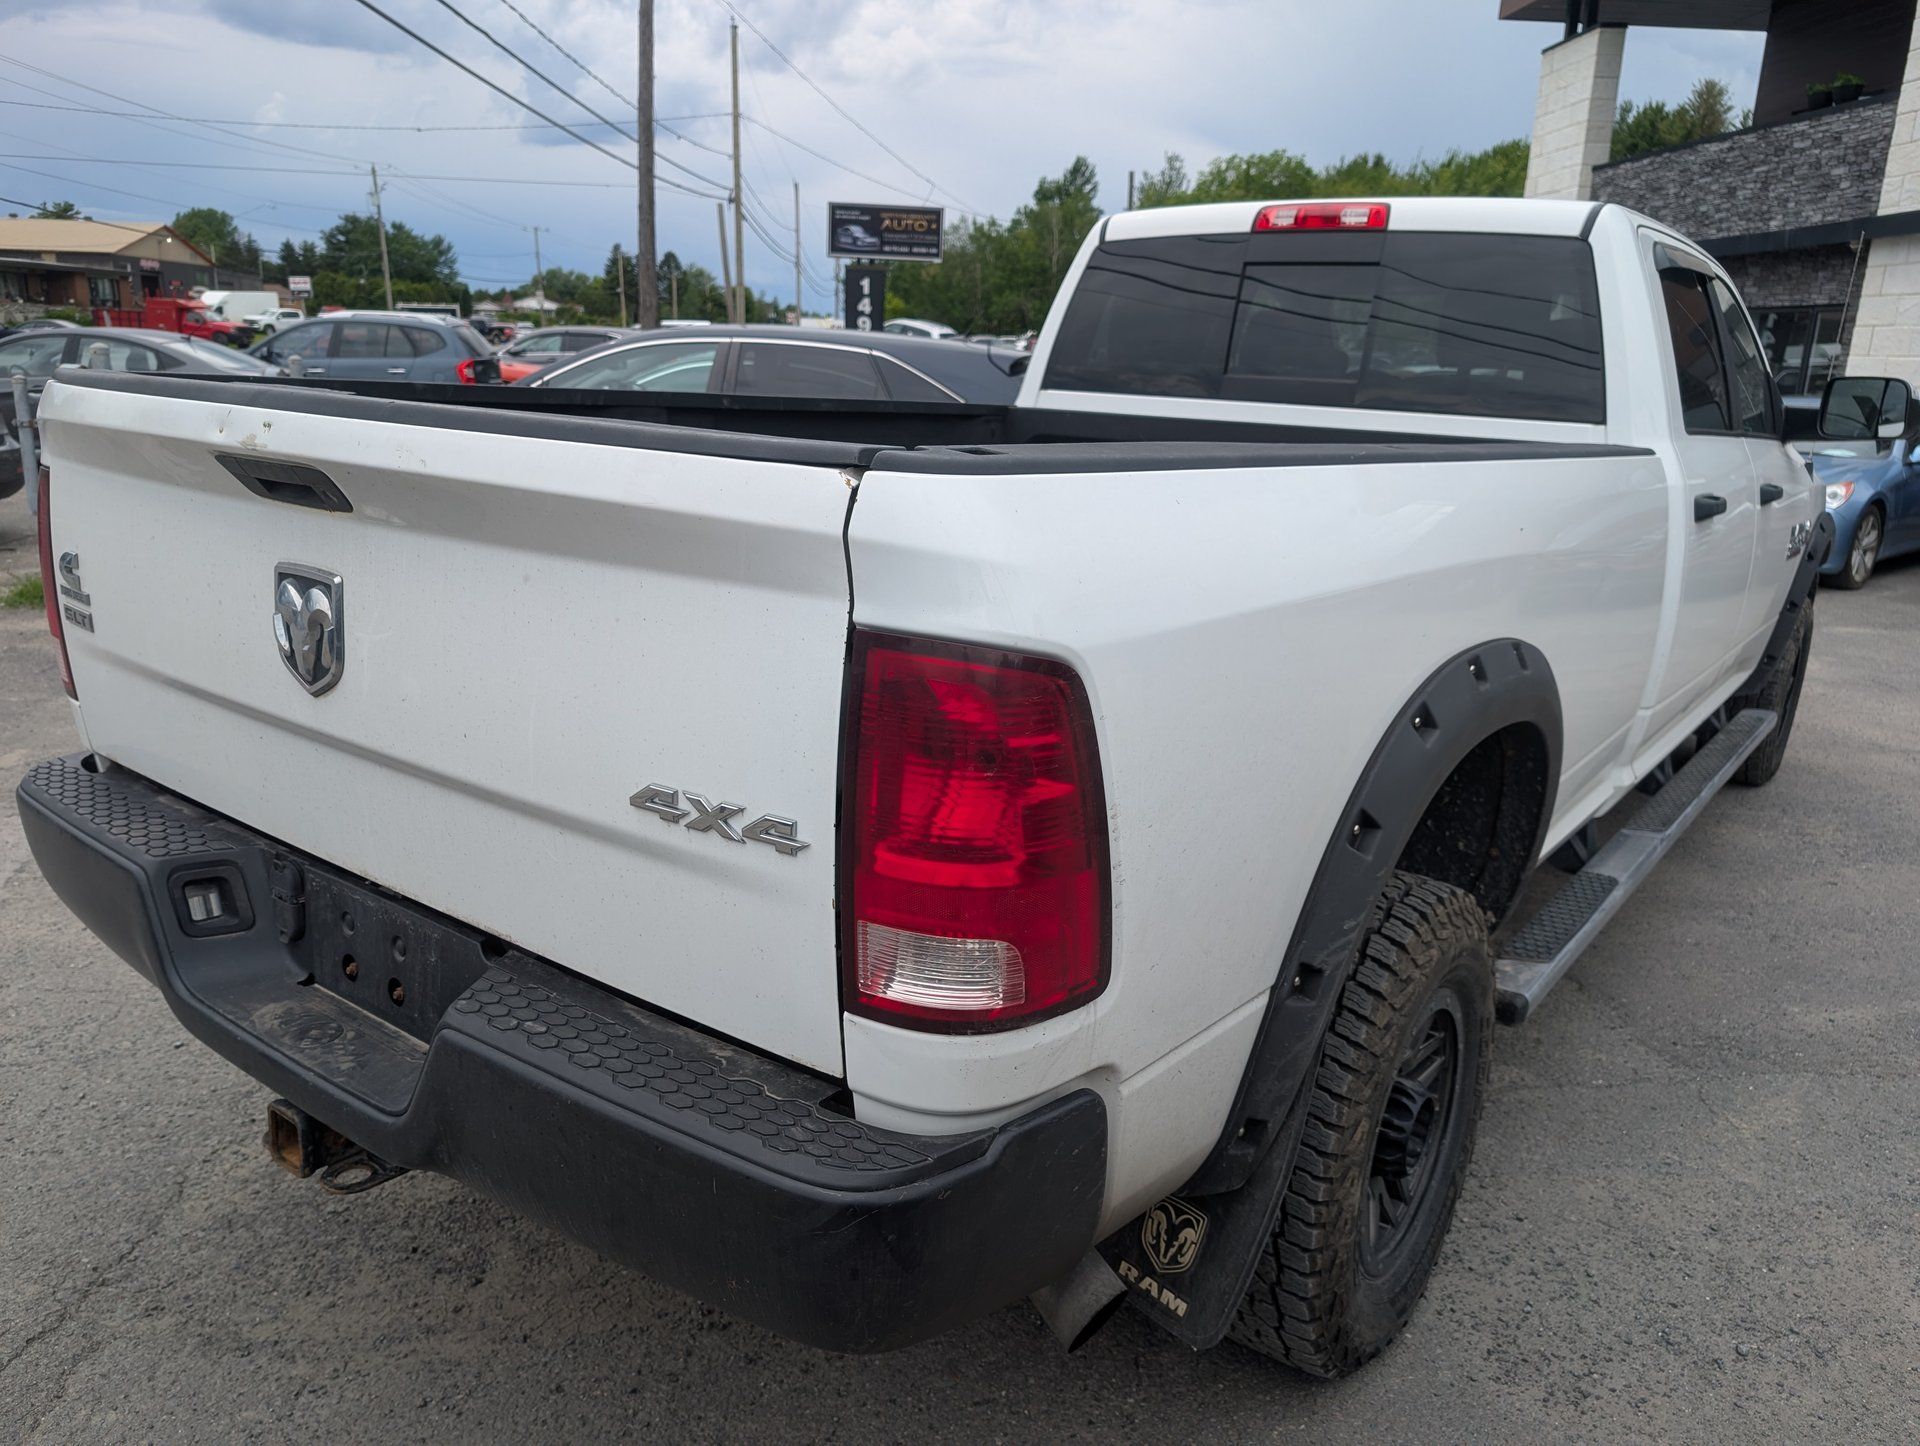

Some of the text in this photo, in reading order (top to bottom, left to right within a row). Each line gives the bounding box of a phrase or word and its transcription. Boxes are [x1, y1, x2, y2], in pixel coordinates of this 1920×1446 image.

[880, 219, 929, 232] AUTO
[64, 605, 89, 629] SLT
[1119, 1260, 1188, 1317] RAM
